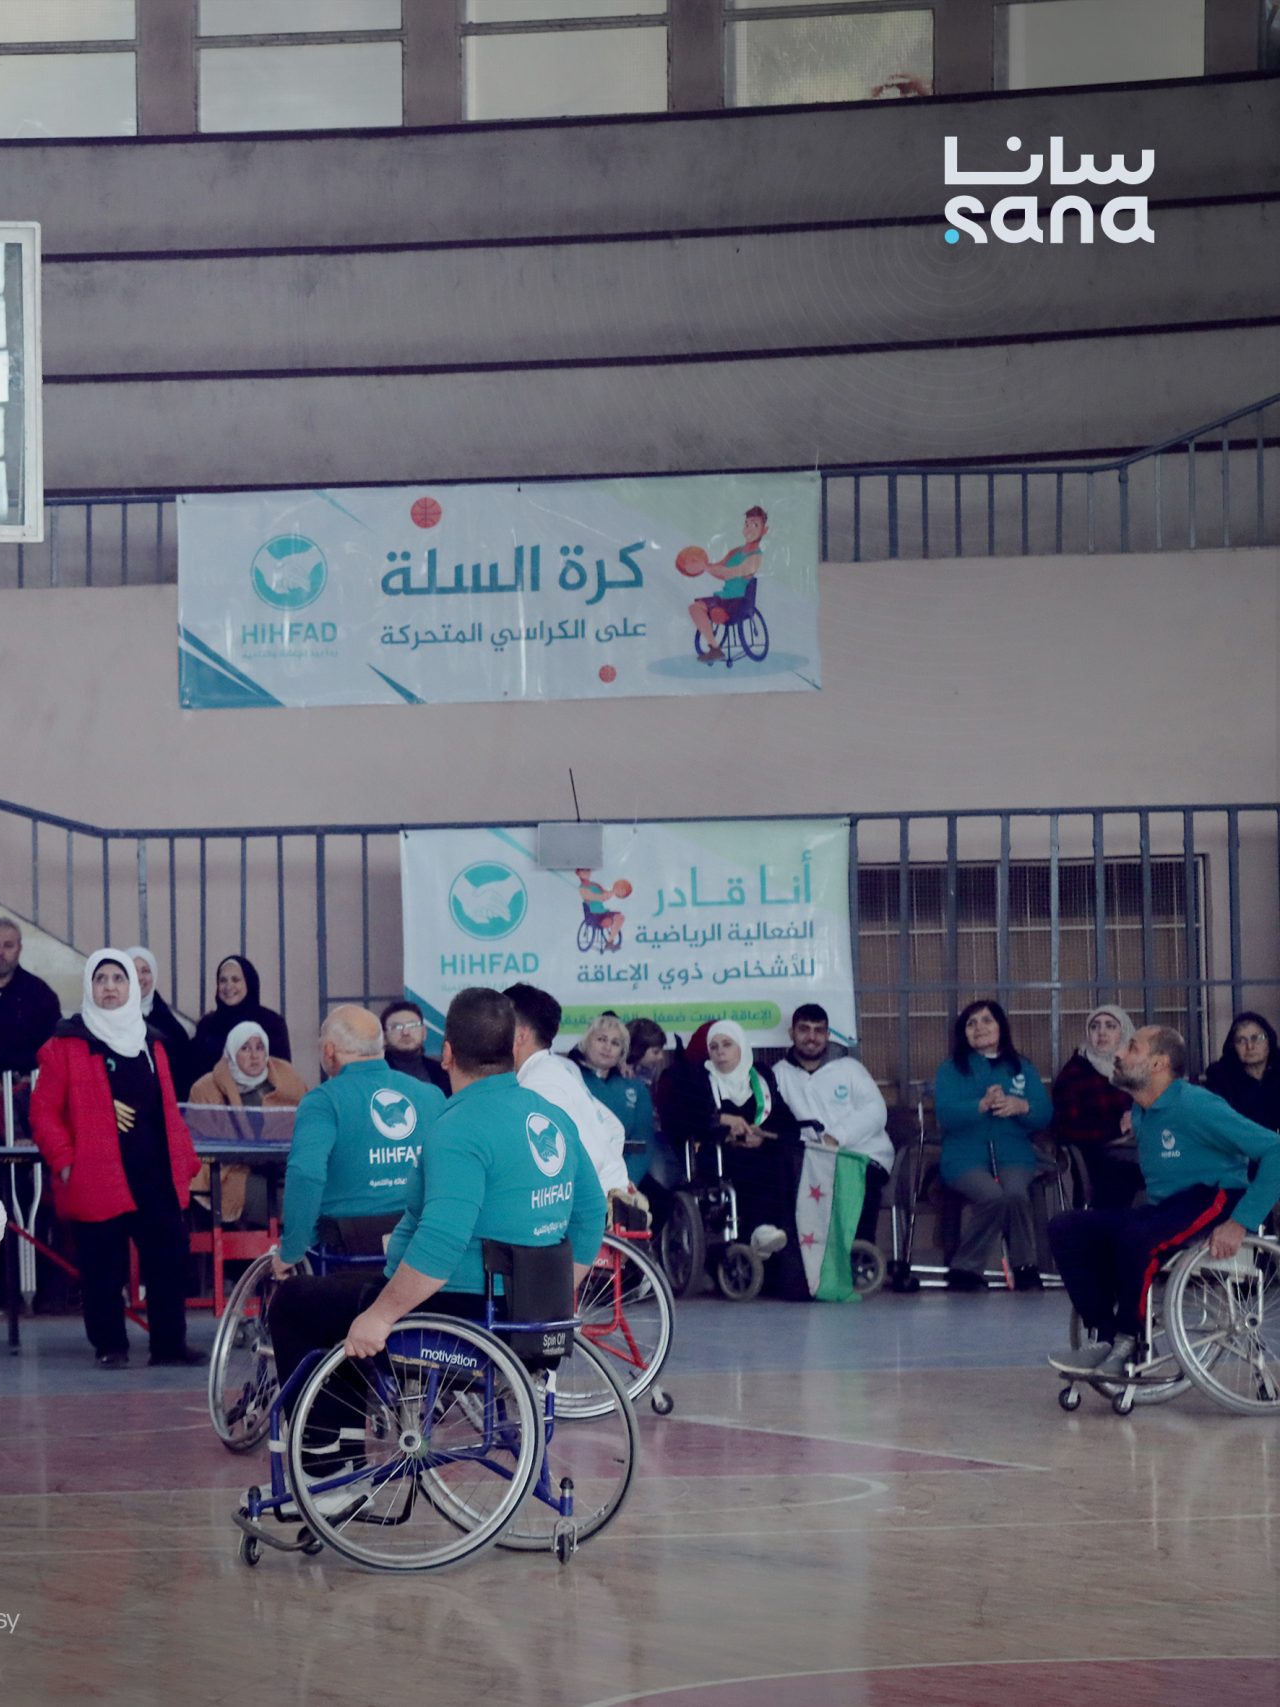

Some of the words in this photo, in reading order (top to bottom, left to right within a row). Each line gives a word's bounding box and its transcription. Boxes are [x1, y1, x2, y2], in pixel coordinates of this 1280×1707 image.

[381, 544, 540, 597] السلة
[558, 540, 646, 606] كرة
[380, 622, 483, 651] المتحركة
[490, 619, 586, 652] الكراسي
[595, 618, 647, 643] على
[651, 866, 746, 918] قادر
[759, 850, 813, 905] أنا
[635, 922, 722, 949] الرياضية
[727, 920, 814, 947] الفعالية
[577, 962, 649, 991] الإعاقة
[657, 962, 704, 990] ذوي
[712, 953, 815, 985] للأشخاص
[531, 1181, 573, 1209] HIHFAD
[421, 1348, 478, 1368] motivation
